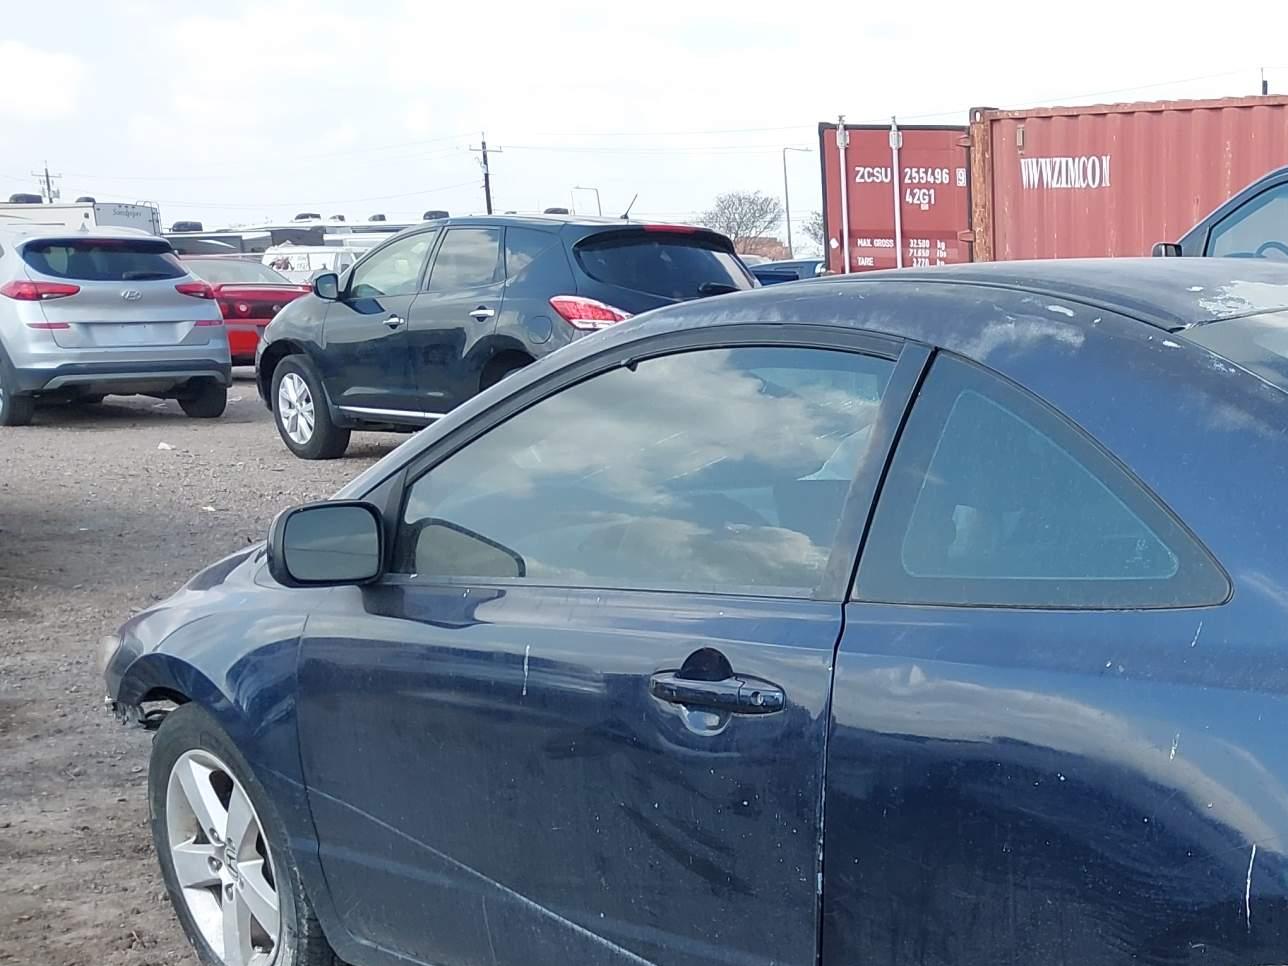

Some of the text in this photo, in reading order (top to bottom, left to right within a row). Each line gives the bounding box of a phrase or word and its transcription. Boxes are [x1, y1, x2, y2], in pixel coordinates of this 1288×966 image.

[855, 166, 891, 183] ZCSU
[904, 168, 950, 184] 255496
[905, 188, 935, 205] 42G1
